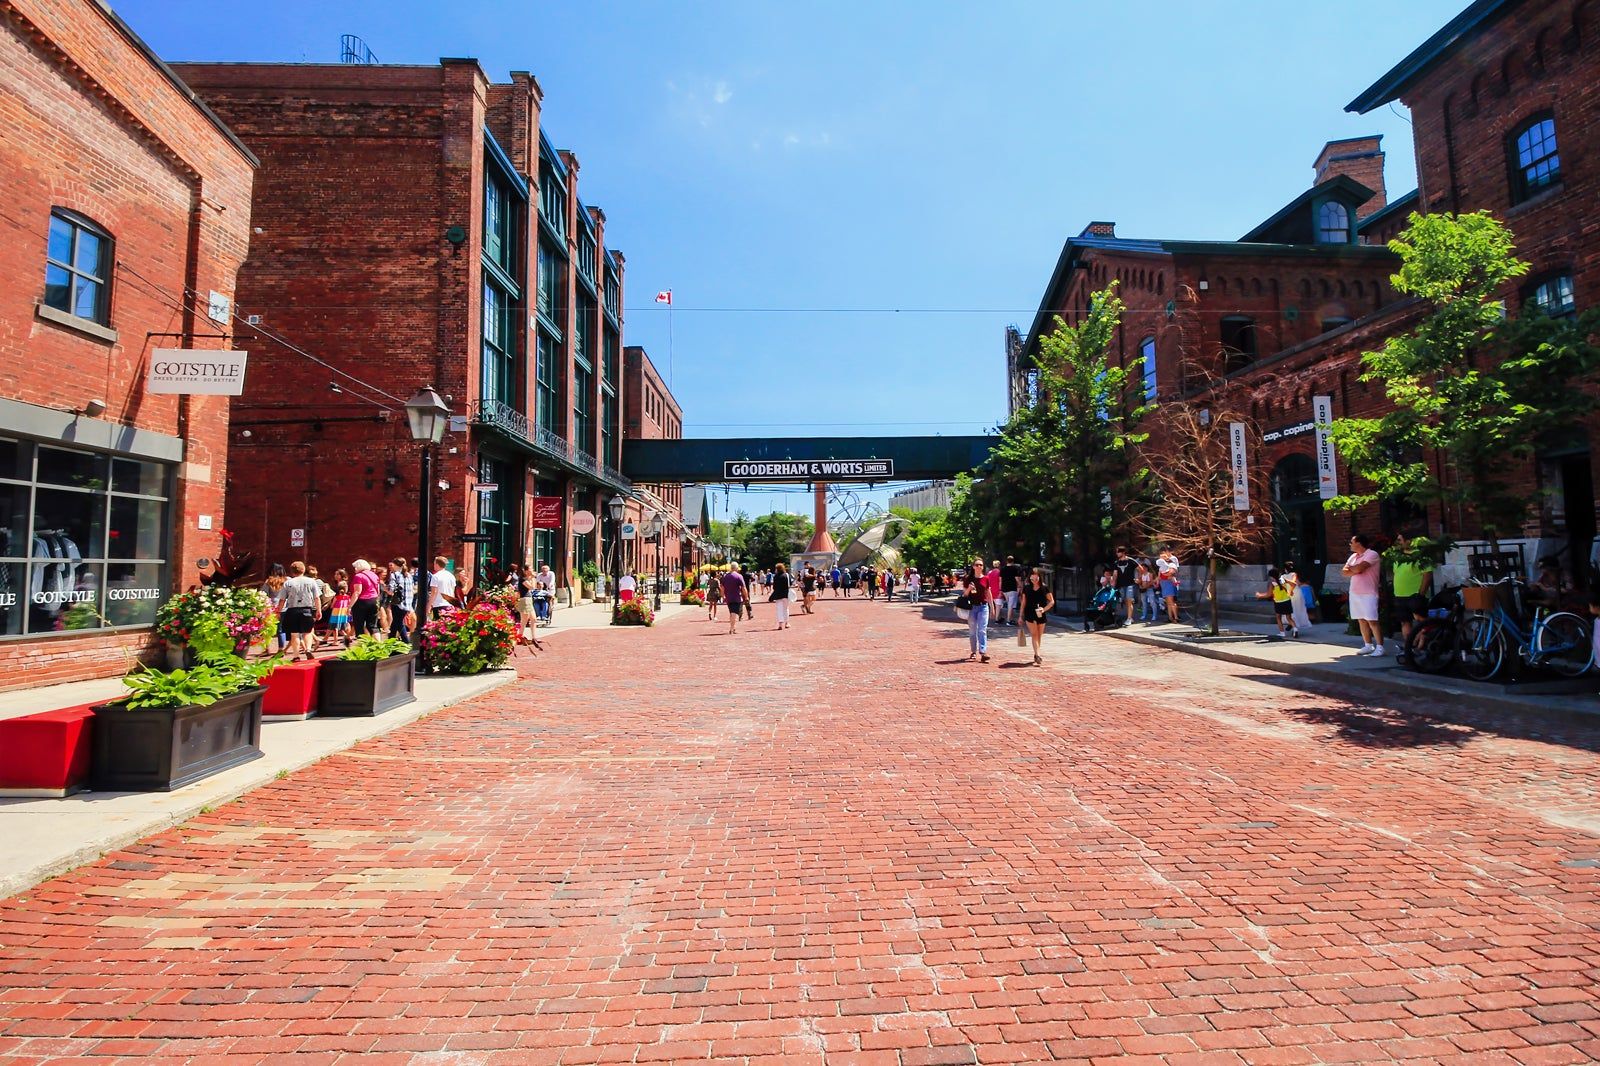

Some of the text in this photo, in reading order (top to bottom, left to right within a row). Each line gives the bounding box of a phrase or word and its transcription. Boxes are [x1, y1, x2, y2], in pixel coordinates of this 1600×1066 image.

[154, 362, 239, 376] GOTSTYLE
[1263, 422, 1314, 441] cop. copine
[731, 464, 808, 476] GOODERHAM
[810, 463, 822, 475] &
[822, 462, 863, 475] WORTS
[33, 590, 95, 604] GOTSTYLE
[109, 588, 160, 600] GOTSTYLE
